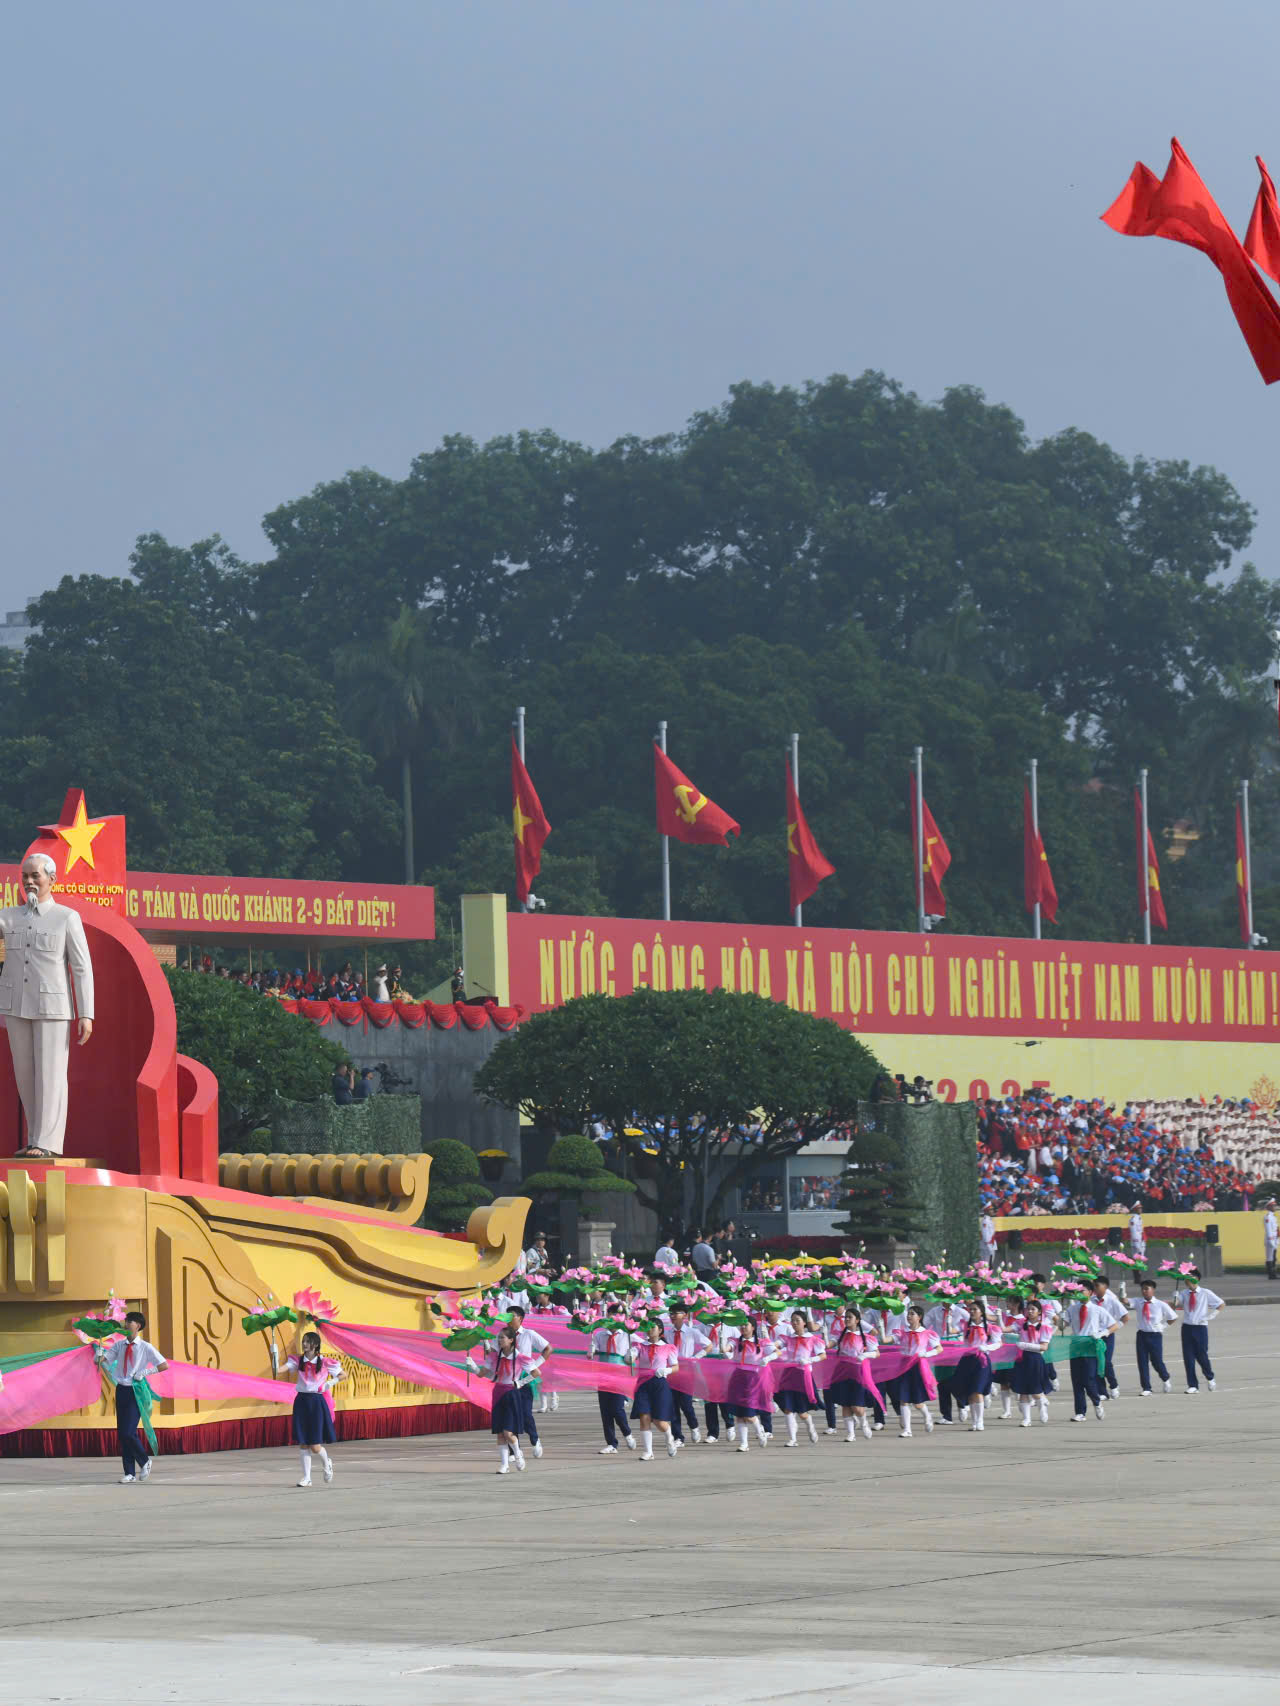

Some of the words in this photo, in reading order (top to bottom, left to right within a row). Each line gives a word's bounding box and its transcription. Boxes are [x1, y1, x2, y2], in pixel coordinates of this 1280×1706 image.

[142, 884, 176, 918] TÁM
[179, 886, 200, 920] VÀ
[203, 885, 240, 922] QUỐC
[244, 891, 293, 923] KHÁNH
[296, 897, 322, 925] 2-9
[326, 890, 354, 926] BẤT
[539, 929, 616, 1005] NƯỚC
[720, 937, 772, 999] HÒA
[785, 941, 816, 1012] XÃ
[830, 941, 873, 1026] HỘI
[888, 940, 936, 1017] CHỦ
[948, 949, 1022, 1019] NGHĨA
[1032, 952, 1083, 1031] VIỆT
[1094, 962, 1141, 1022] NAM
[1152, 957, 1212, 1024] MUÔN
